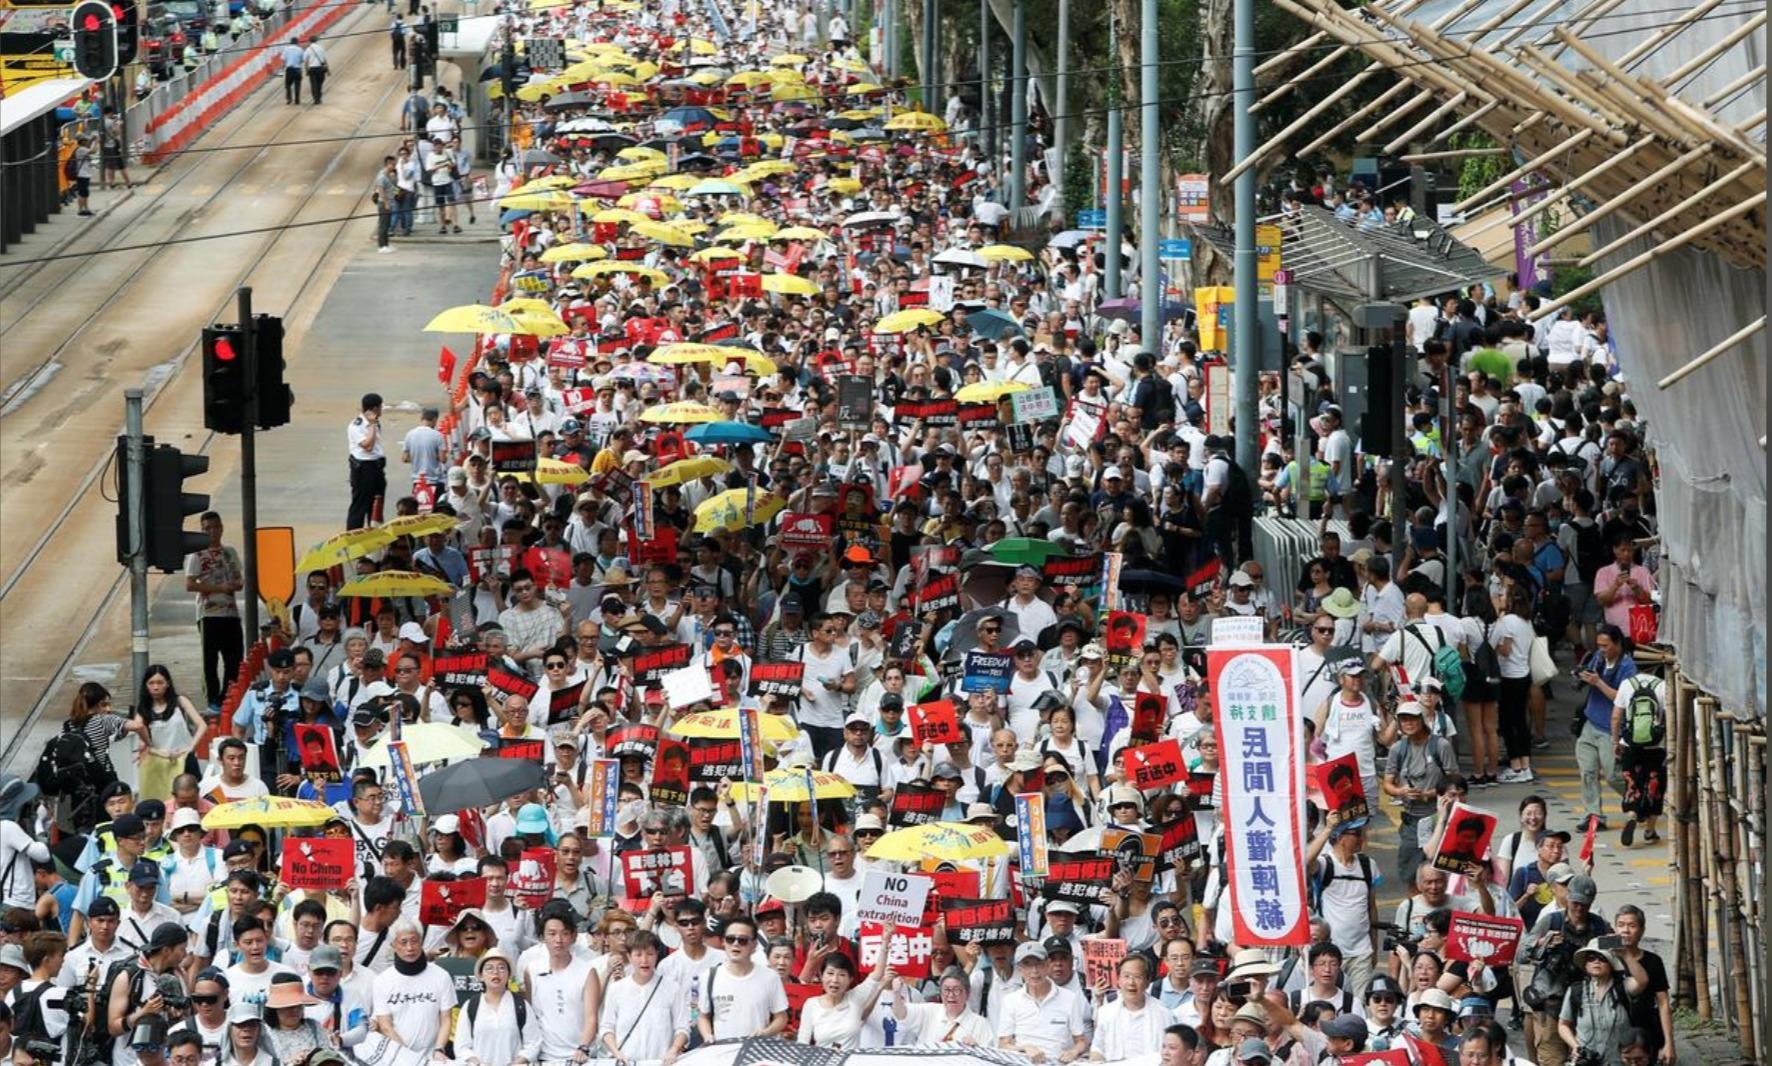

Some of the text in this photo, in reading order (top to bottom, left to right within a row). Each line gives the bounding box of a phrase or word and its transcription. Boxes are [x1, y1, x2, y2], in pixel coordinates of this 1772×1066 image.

[1135, 761, 1177, 784] 反送中
[292, 862, 342, 874] No China
[629, 867, 686, 897] 下台
[884, 877, 908, 893] NO
[876, 894, 909, 909] China
[857, 908, 920, 925] extradition
[861, 931, 933, 968] 反送中
